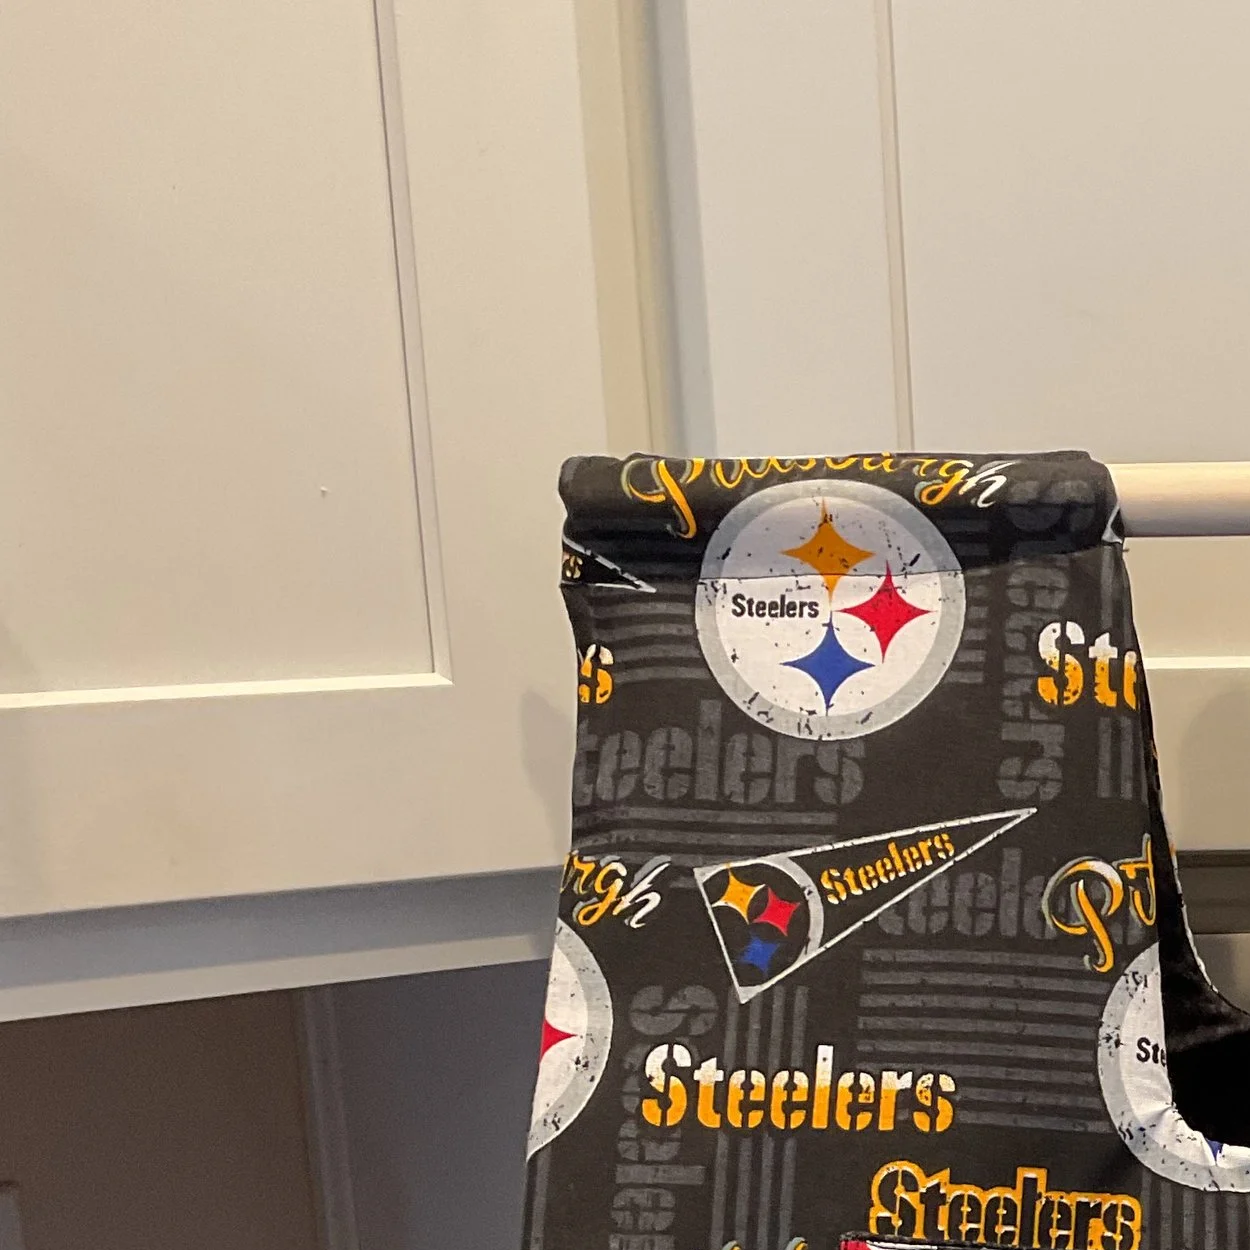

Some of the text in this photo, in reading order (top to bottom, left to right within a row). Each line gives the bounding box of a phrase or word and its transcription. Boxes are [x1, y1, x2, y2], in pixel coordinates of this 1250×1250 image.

[732, 593, 819, 618] Steelers
[819, 832, 955, 905] Steelers
[641, 1042, 957, 1133] Steelers
